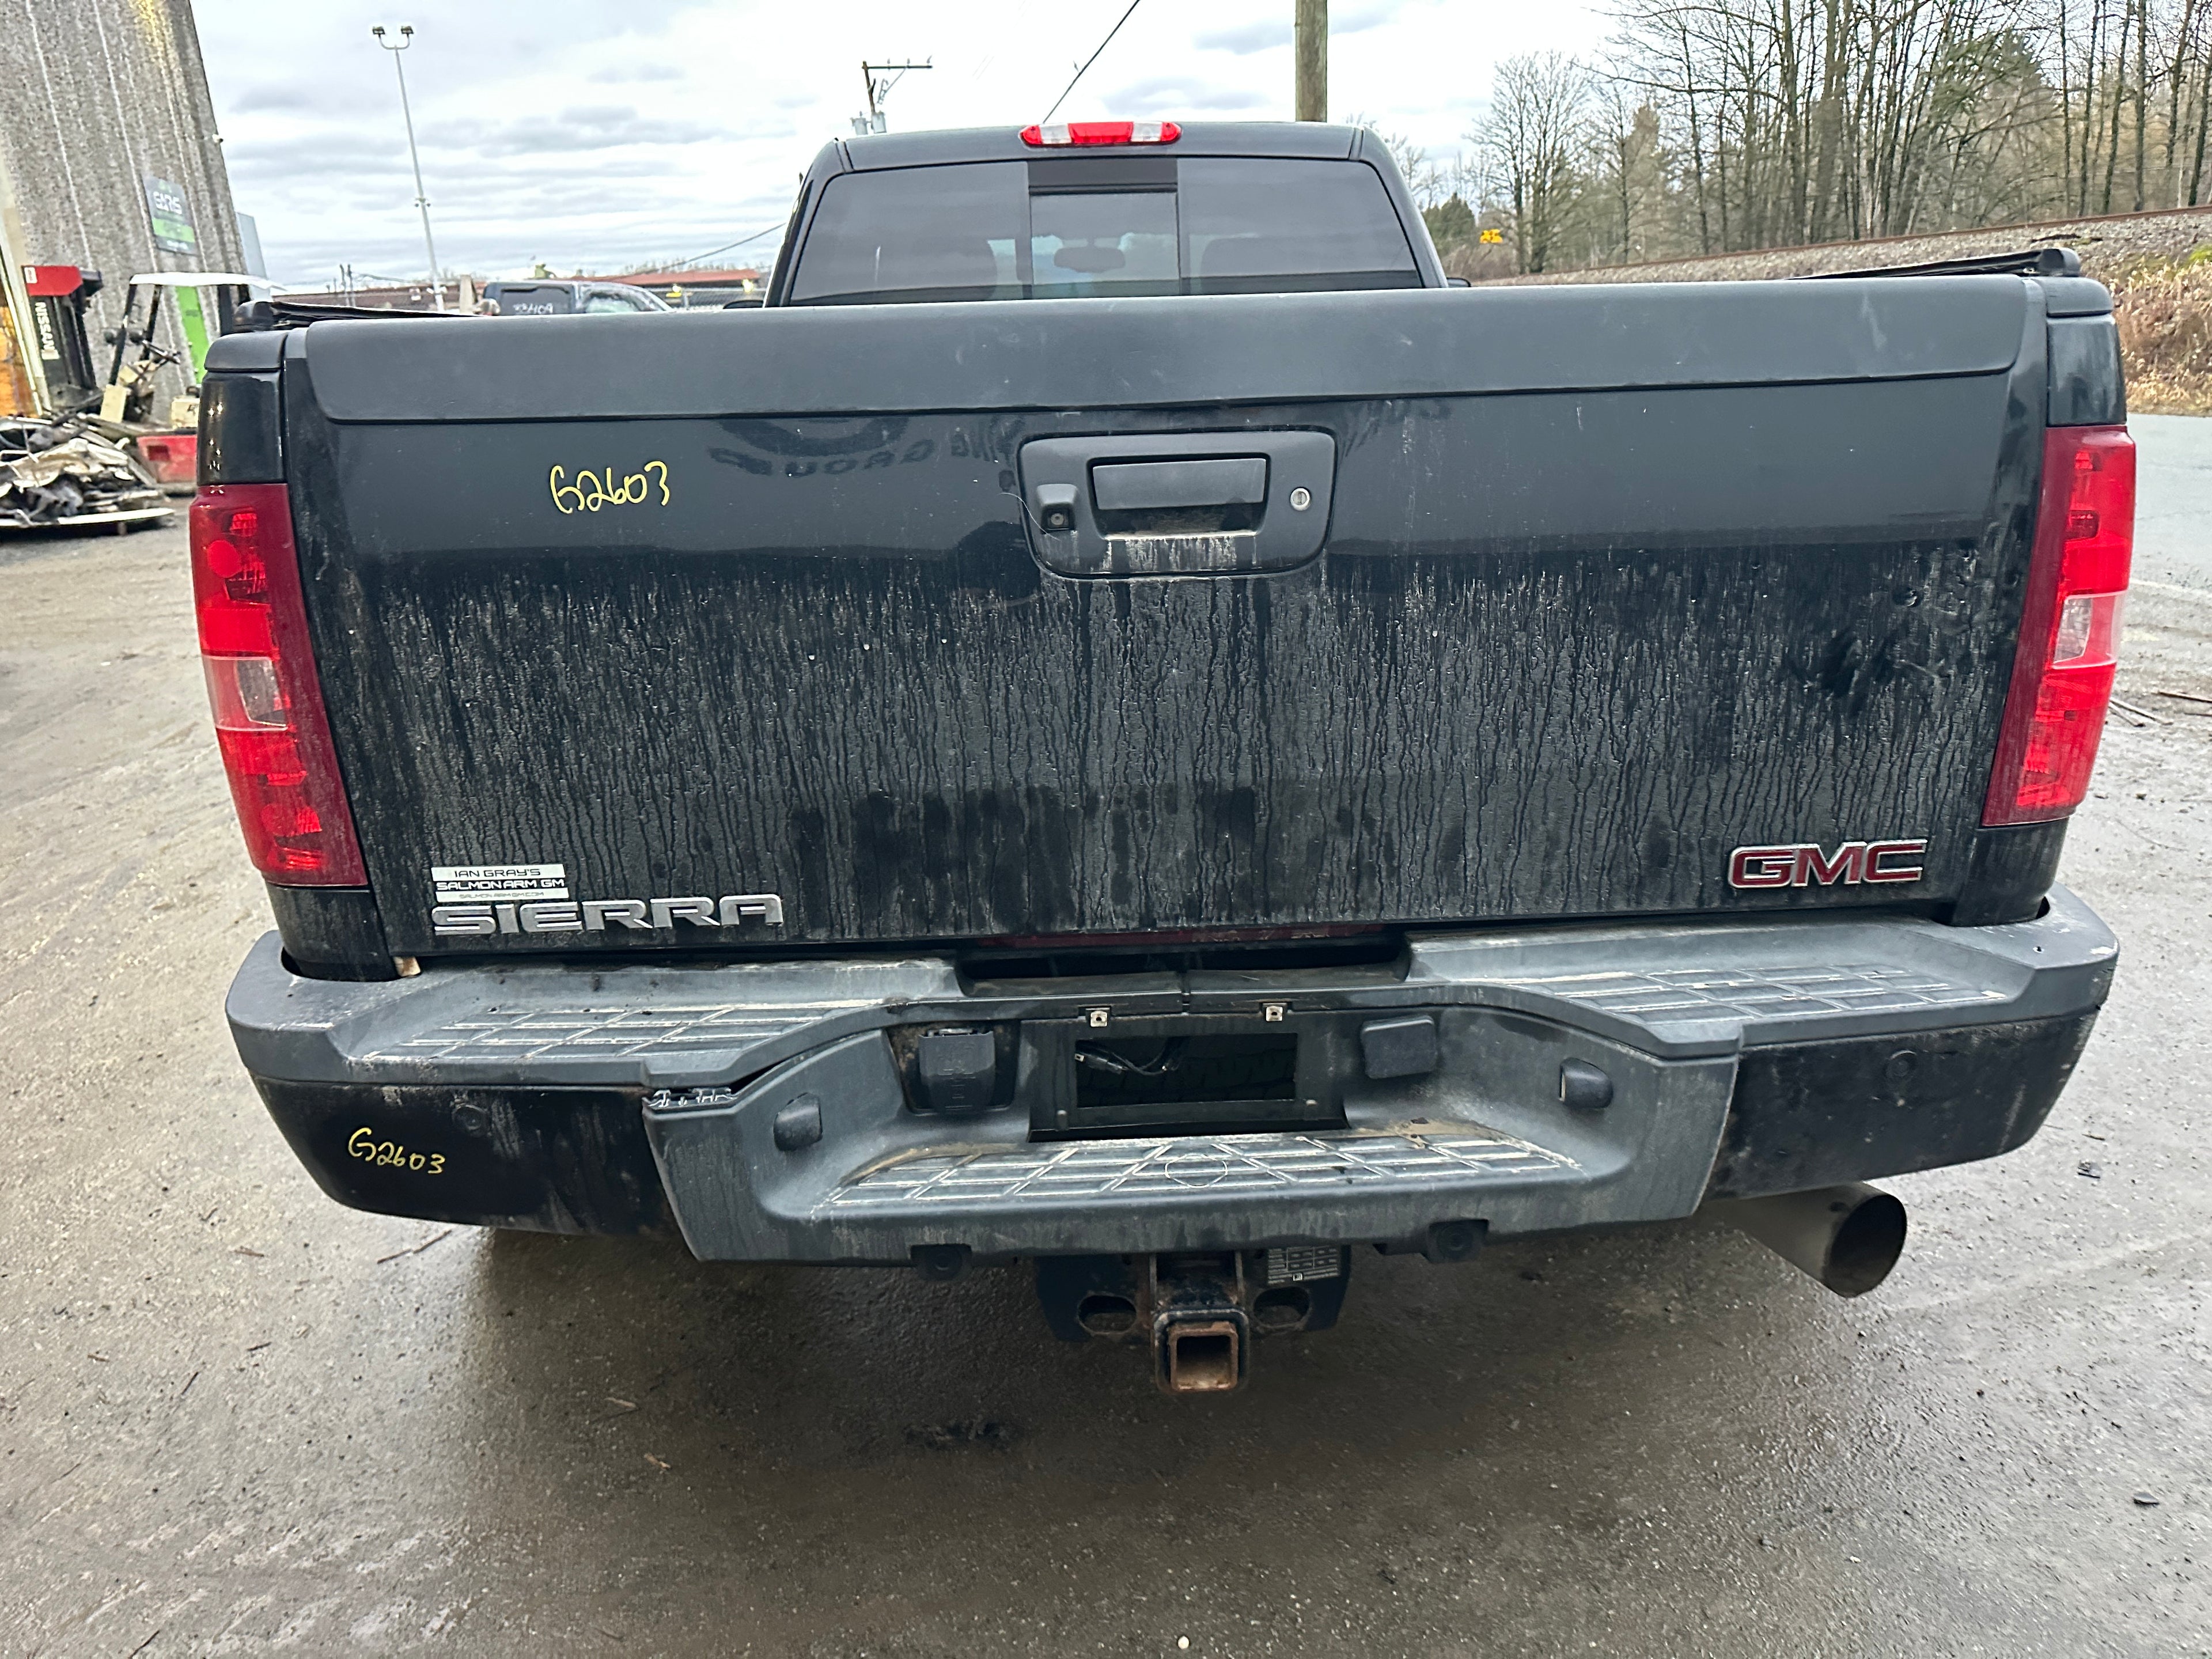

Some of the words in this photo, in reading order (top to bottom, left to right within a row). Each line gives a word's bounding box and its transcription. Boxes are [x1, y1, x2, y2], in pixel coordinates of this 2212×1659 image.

[35, 302, 56, 350] NISSAN
[550, 460, 671, 514] G2603
[454, 870, 480, 878] IAN
[484, 869, 541, 878] GRAY'S
[540, 878, 565, 888] GM
[1729, 838, 1928, 889] GMC
[431, 893, 784, 936] SIERRA
[348, 1127, 446, 1174] G2603
